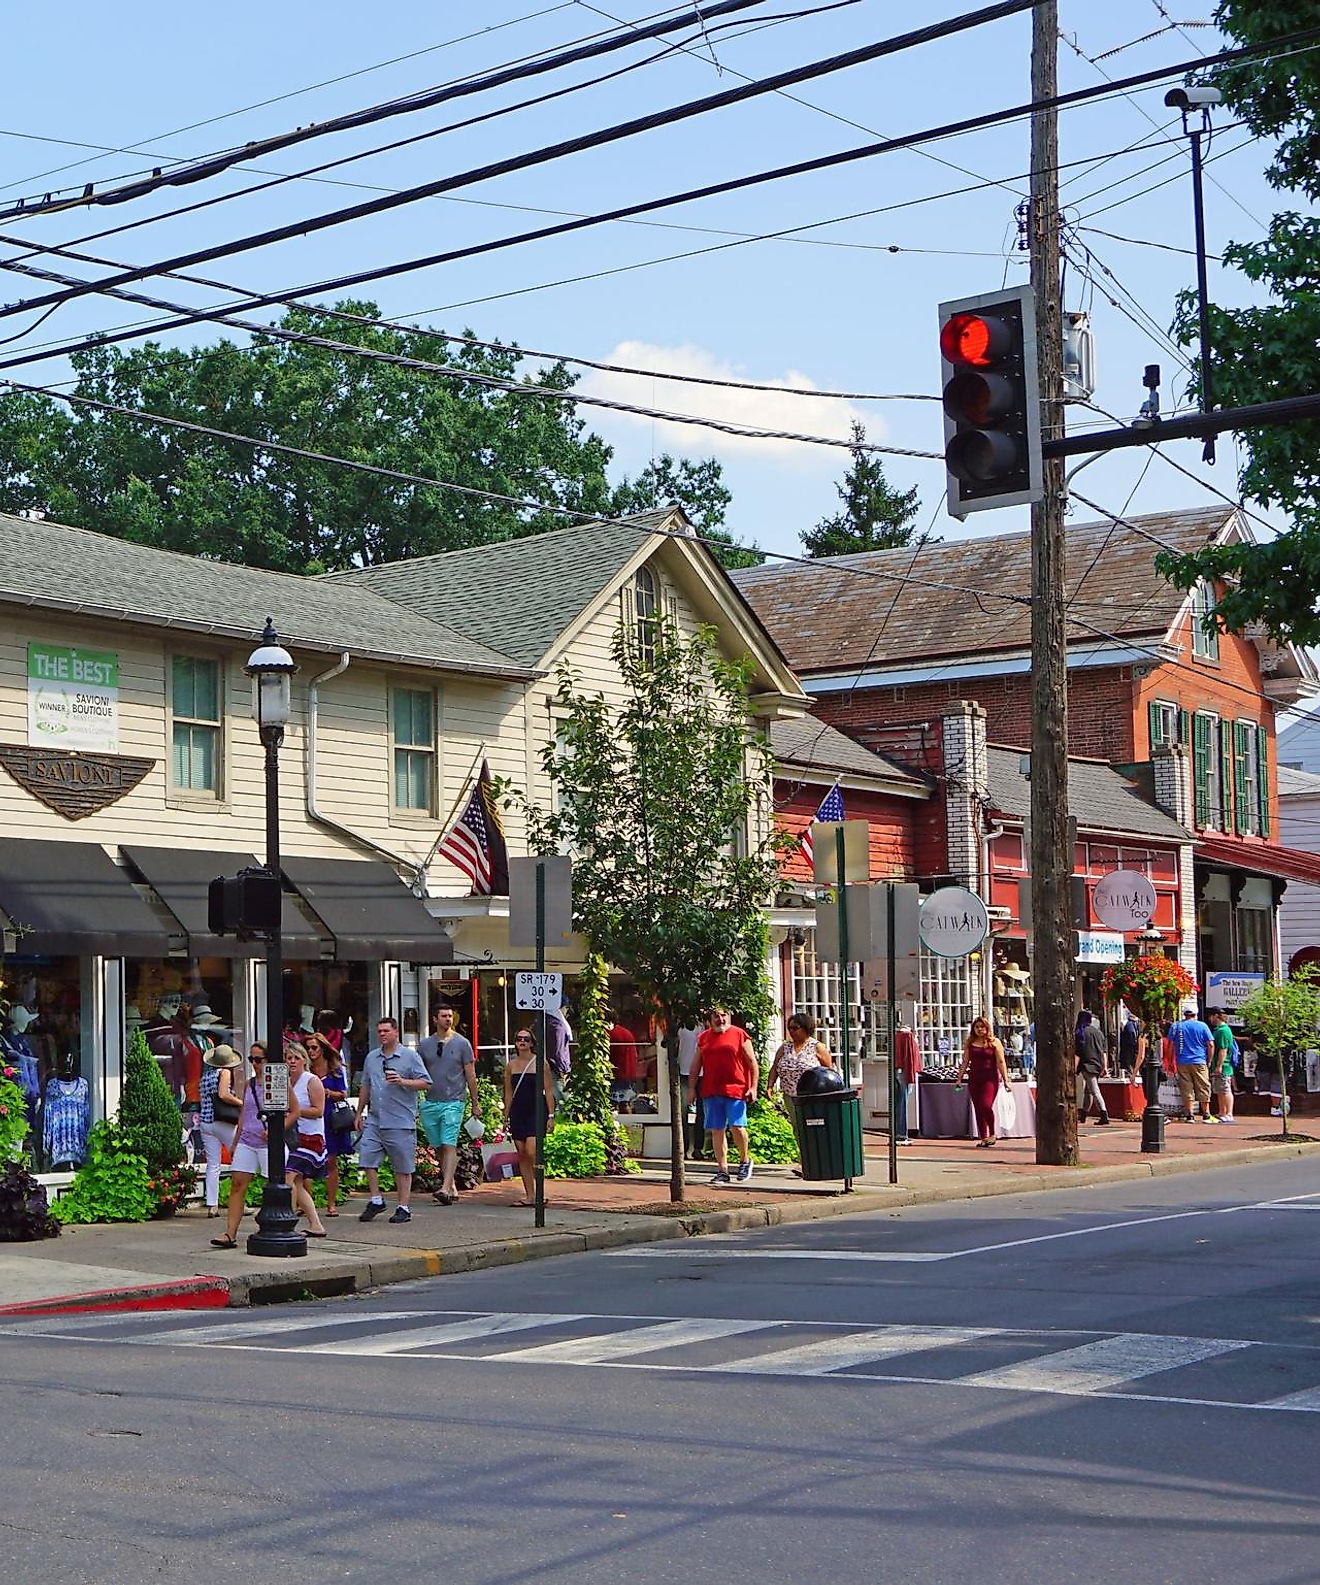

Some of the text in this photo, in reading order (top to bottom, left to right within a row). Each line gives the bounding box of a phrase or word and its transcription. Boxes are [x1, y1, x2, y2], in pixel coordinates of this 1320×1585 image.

[35, 654, 113, 684] THE BEST
[76, 693, 110, 706] SAVIONI
[39, 702, 66, 712] WINNER
[72, 704, 113, 717] BOUTIQUE
[35, 760, 114, 785] SAVIONI
[1079, 939, 1122, 959] rand Opening
[521, 974, 533, 984] SR
[531, 986, 545, 997] 30
[531, 998, 545, 1009] 30
